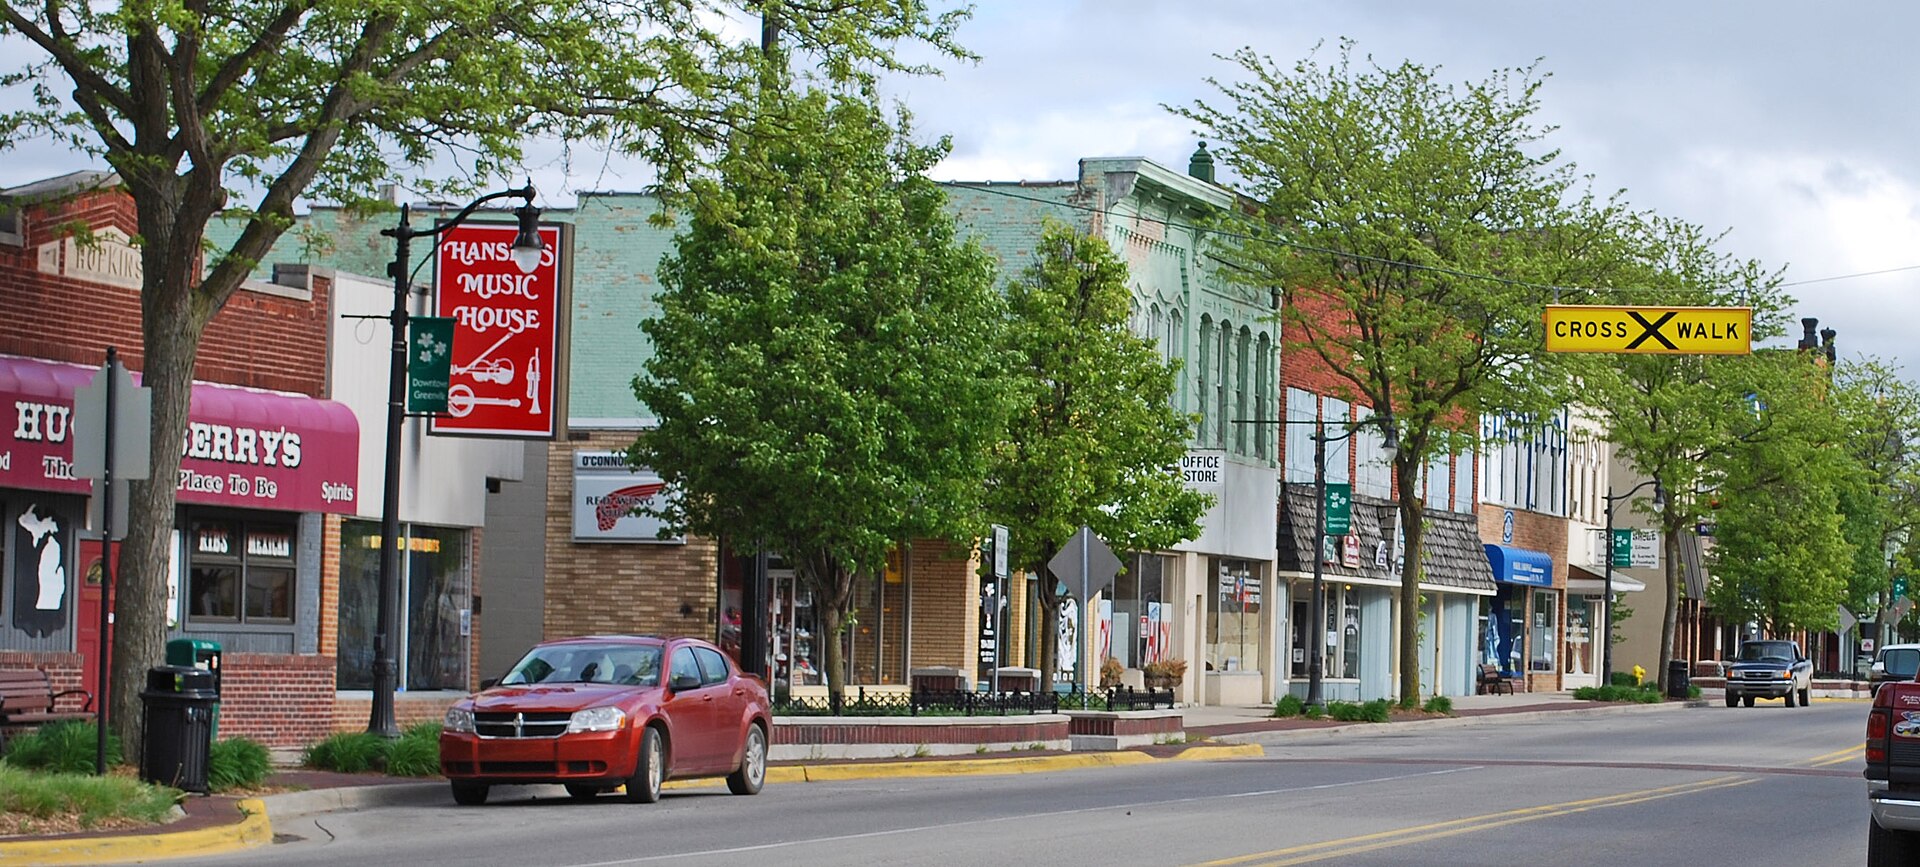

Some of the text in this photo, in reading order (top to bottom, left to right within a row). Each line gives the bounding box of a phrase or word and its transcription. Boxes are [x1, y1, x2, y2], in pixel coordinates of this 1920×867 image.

[75, 244, 142, 280] HOPKINS
[444, 241, 555, 267] HANSS
[457, 273, 539, 300] MUSIC
[452, 306, 541, 334] HOUSE
[1554, 321, 1628, 338] CROSS
[1676, 322, 1739, 340] WALK
[582, 456, 628, 467] O'CONNO
[1182, 456, 1219, 468] OFFICE
[178, 470, 223, 493] Place
[229, 474, 250, 496] To
[254, 476, 277, 498] Be
[1184, 470, 1217, 482] STORE
[321, 481, 353, 503] Spirits
[586, 496, 655, 506] RED WING
